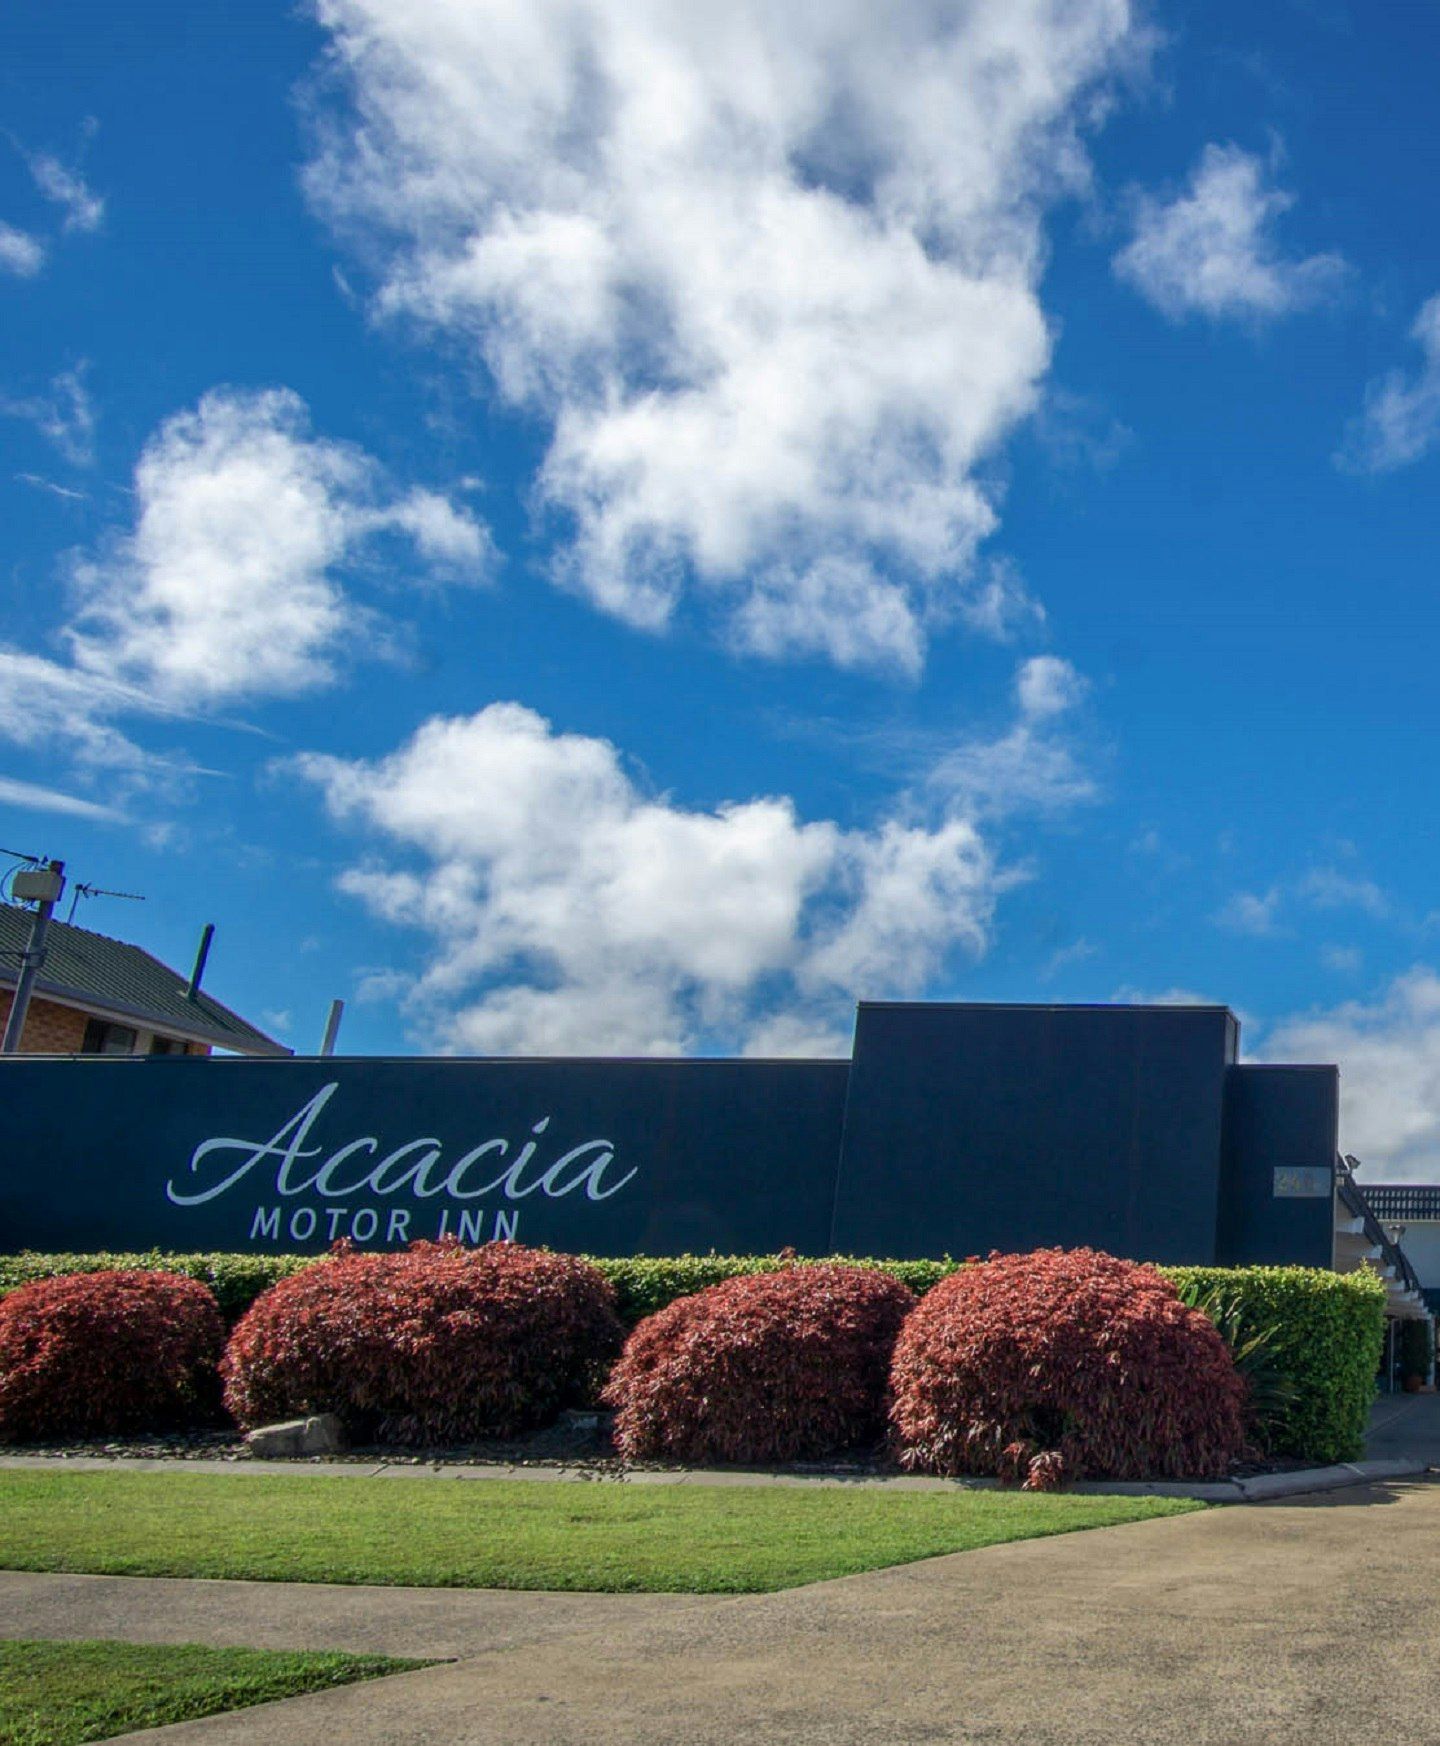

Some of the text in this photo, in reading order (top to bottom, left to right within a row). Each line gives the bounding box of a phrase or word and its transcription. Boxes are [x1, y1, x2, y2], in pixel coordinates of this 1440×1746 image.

[166, 1081, 639, 1206] Acacia
[249, 1206, 521, 1242] MOTOR INN
